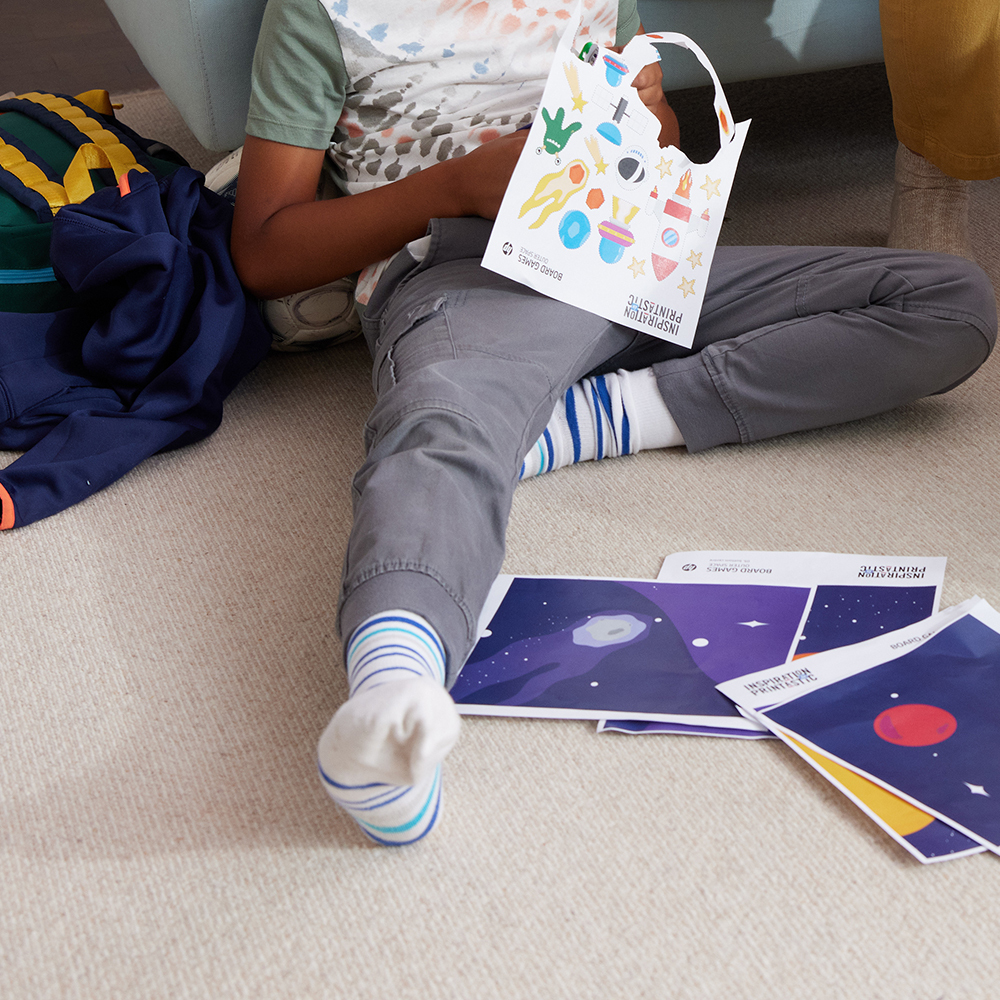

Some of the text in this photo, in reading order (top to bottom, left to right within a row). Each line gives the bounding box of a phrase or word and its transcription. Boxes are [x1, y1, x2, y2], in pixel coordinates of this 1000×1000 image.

[517, 253, 564, 281] BOARD GAMES
[624, 306, 680, 336] INSPIRATION
[627, 294, 684, 324] PRINTASTIC
[860, 565, 926, 573] PRINTASTIC
[890, 637, 921, 650] BOARD
[743, 667, 812, 691] INSPIRATION
[751, 674, 818, 696] PRINTASTIC
